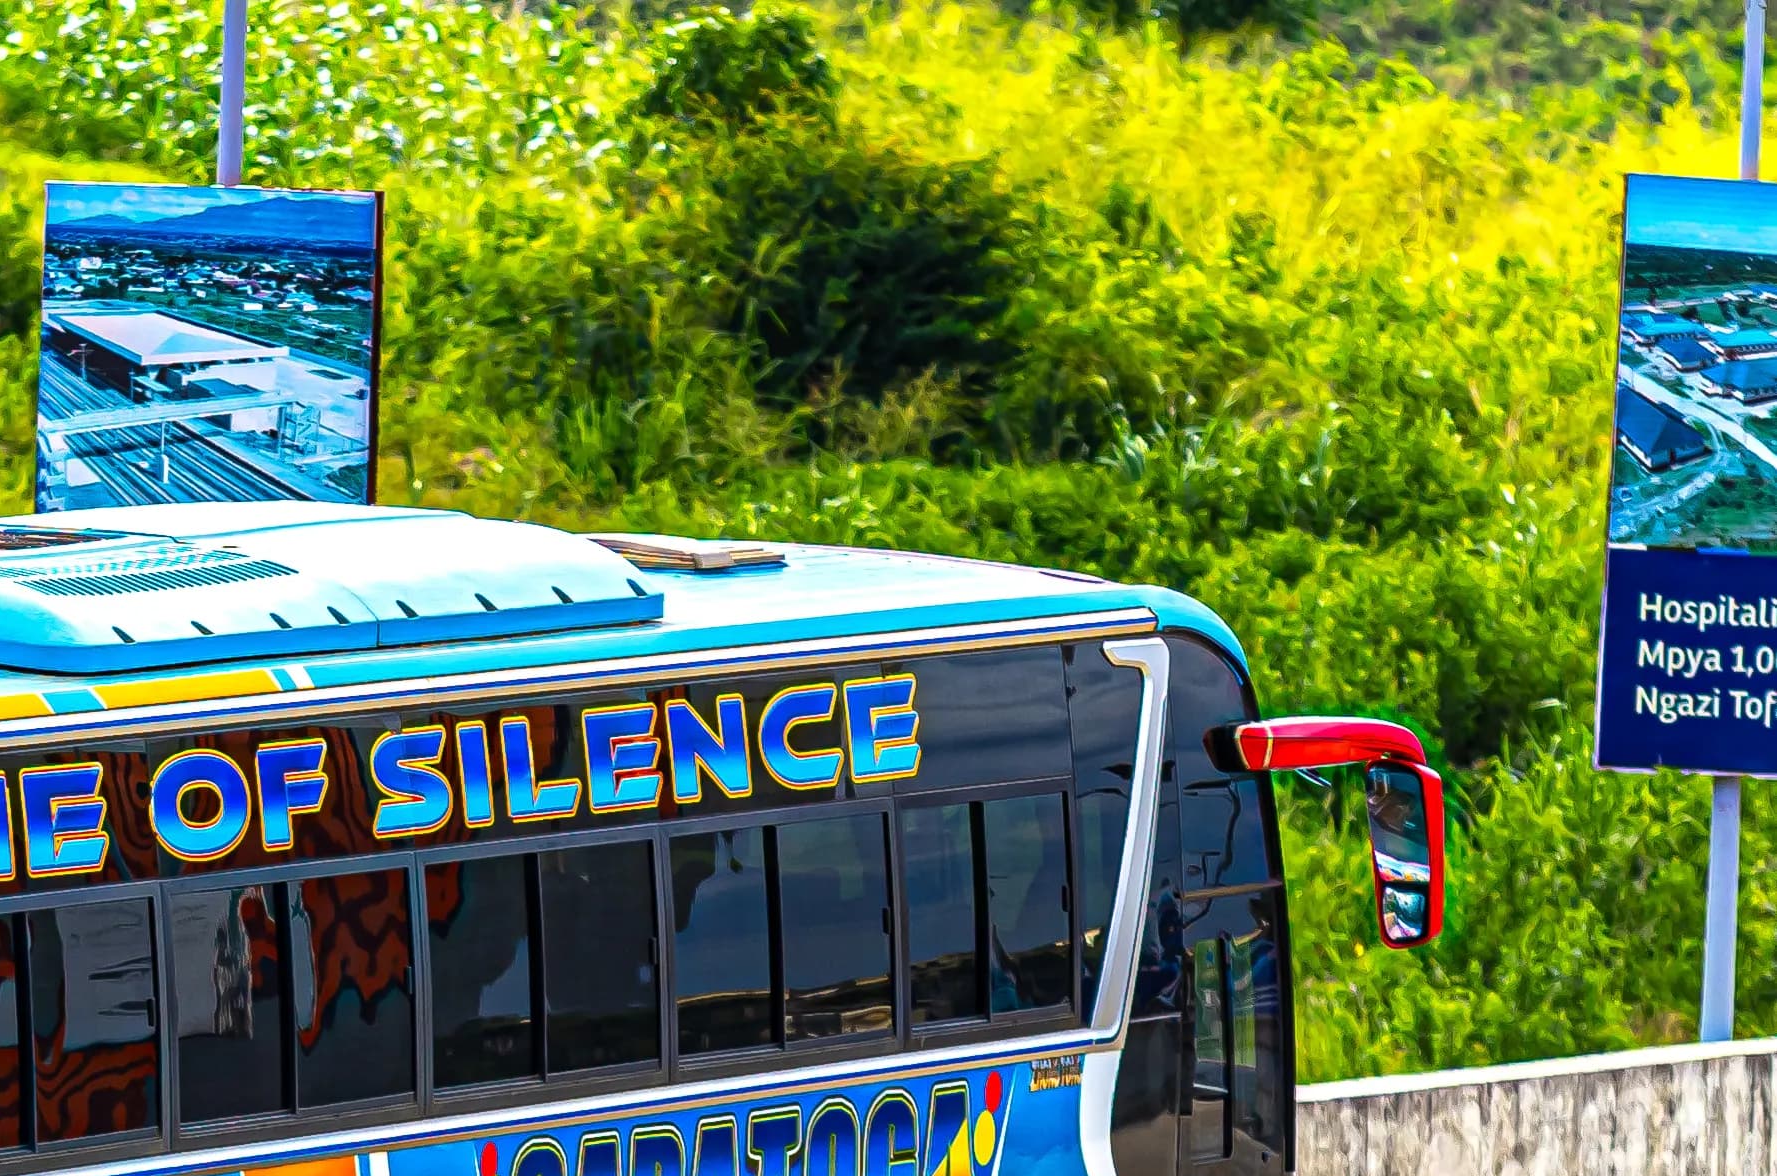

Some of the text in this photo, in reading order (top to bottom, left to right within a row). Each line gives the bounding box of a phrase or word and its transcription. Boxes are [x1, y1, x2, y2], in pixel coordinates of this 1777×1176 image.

[1638, 639, 1777, 678] Mpya 1,0
[1635, 684, 1777, 728] Ngazi Tof
[150, 738, 328, 861] OF
[372, 673, 921, 839] SILENCE
